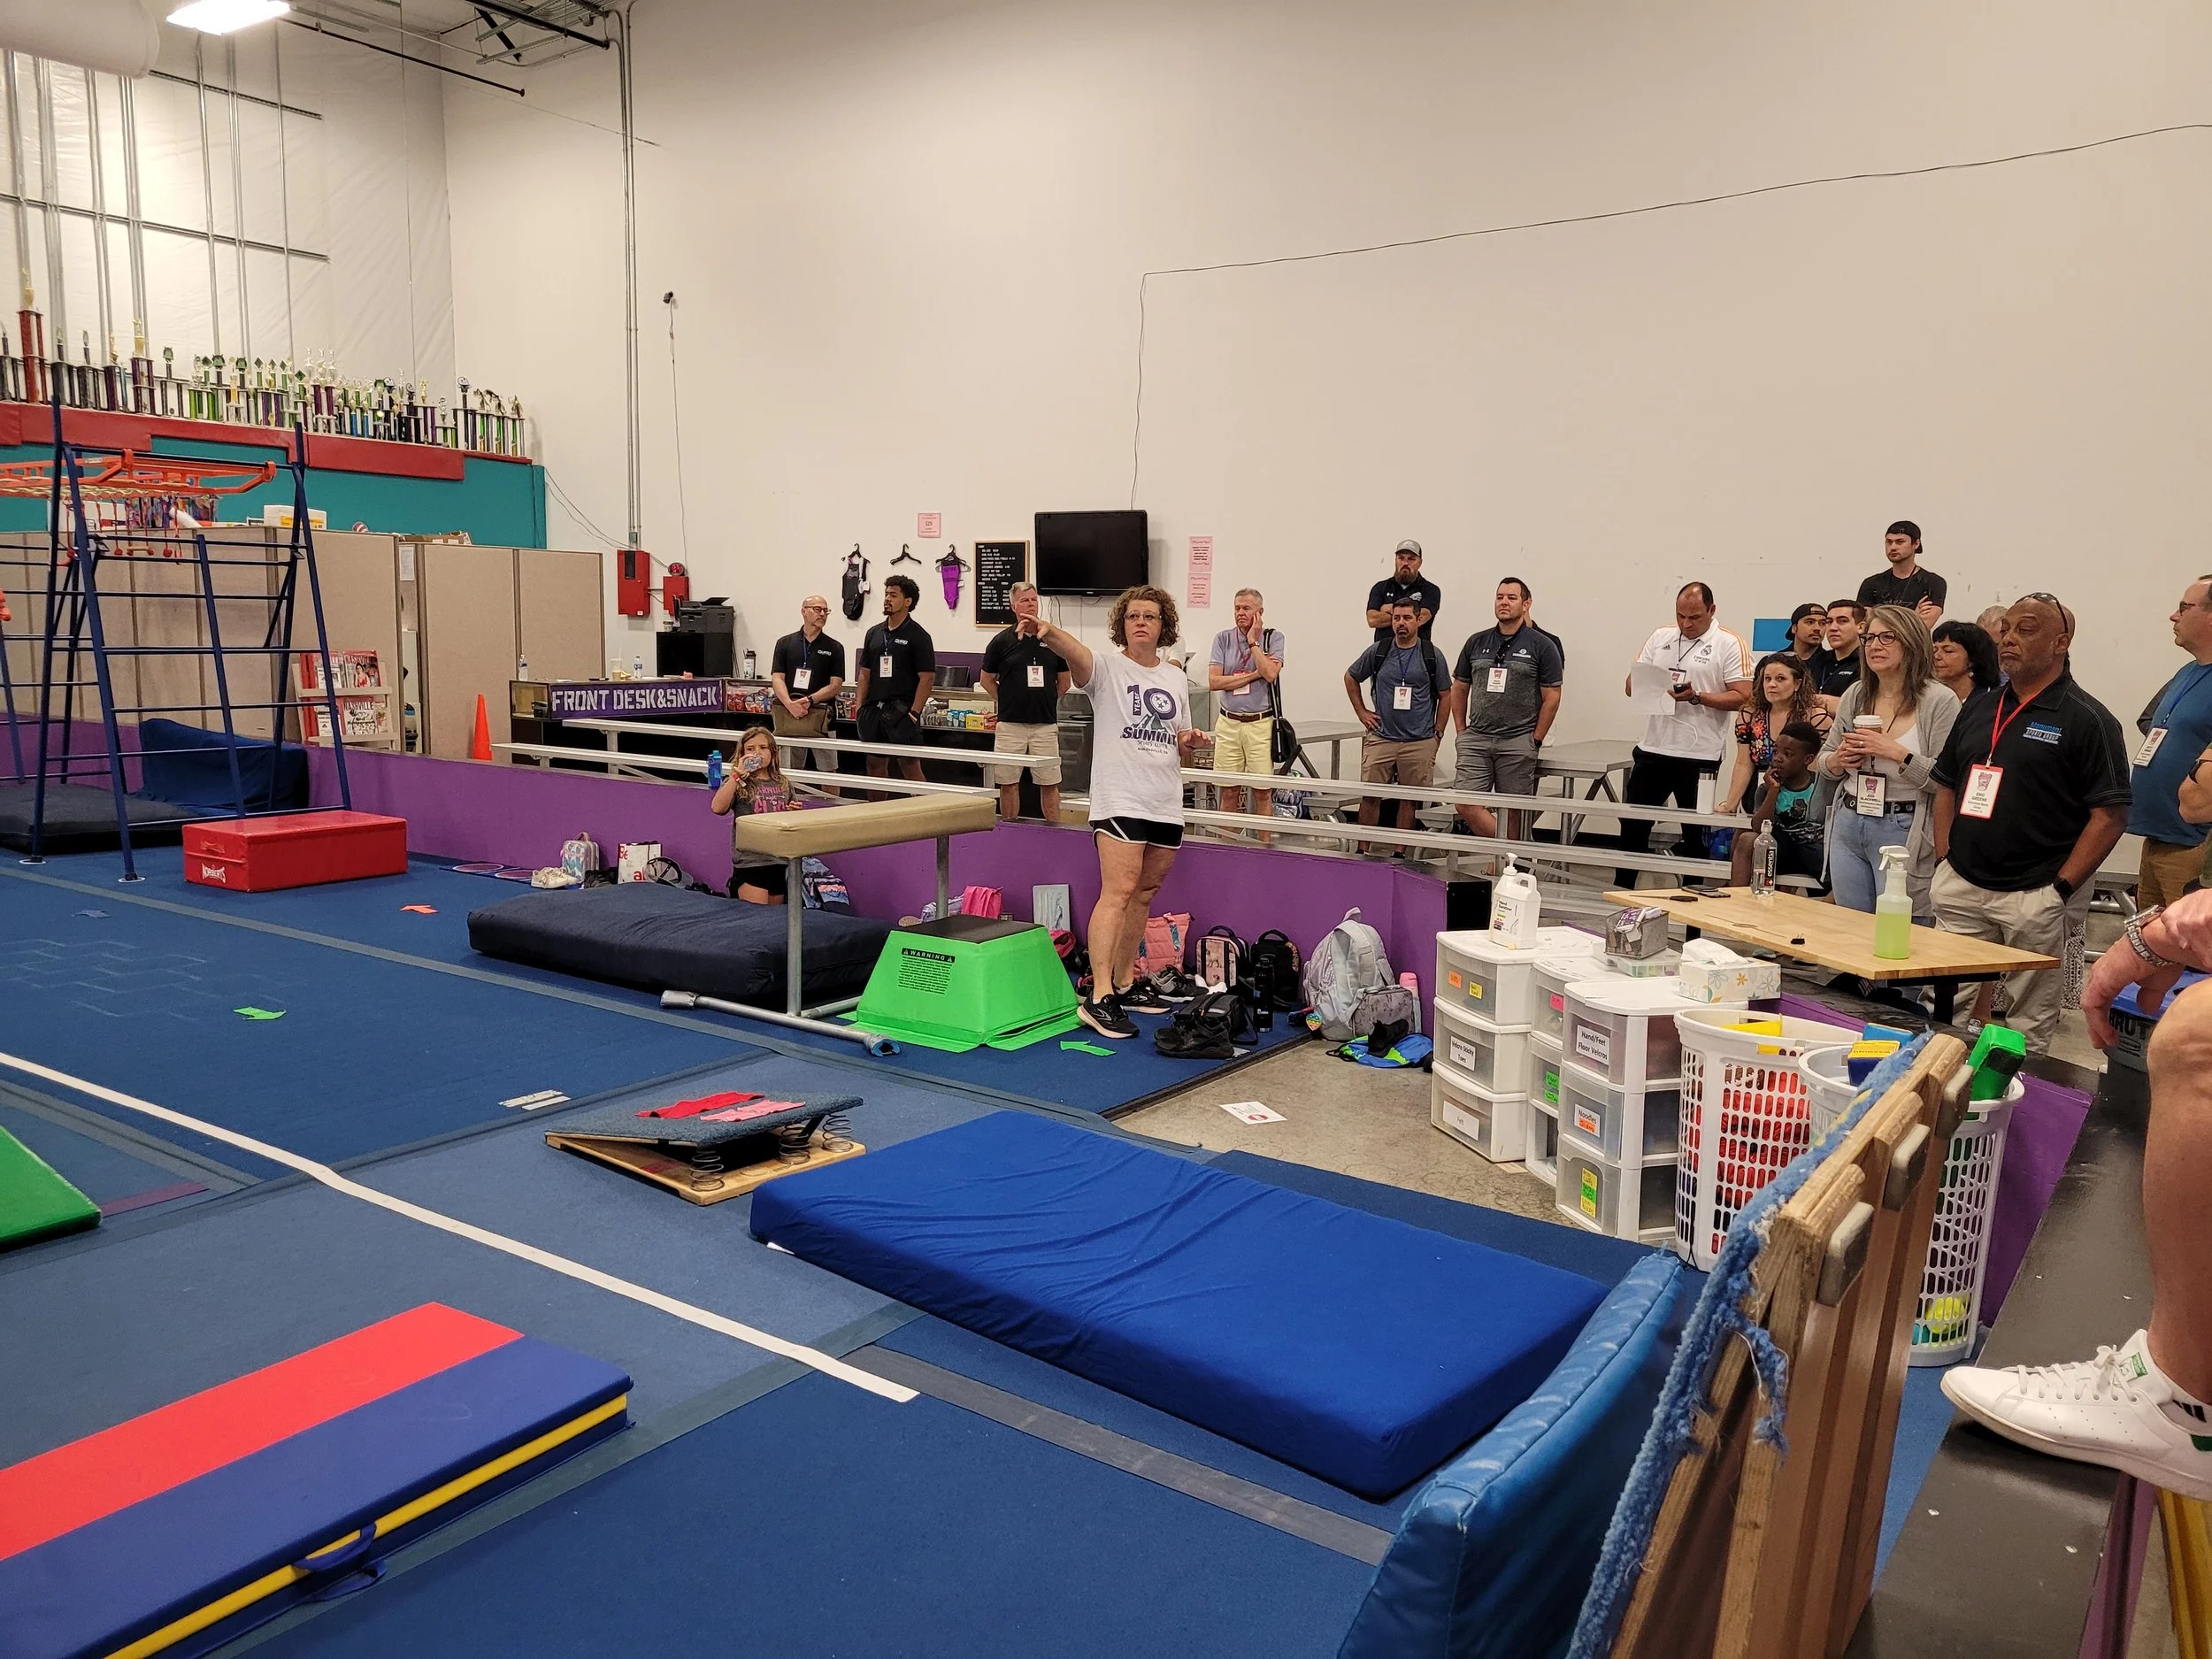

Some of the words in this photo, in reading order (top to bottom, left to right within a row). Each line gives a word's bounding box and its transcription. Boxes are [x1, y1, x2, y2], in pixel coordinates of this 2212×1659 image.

[552, 690, 610, 711] FRONT
[613, 687, 718, 710] DESK&SNACK
[2030, 722, 2062, 733] Monument
[1122, 726, 1177, 745] SUMMIT
[910, 950, 945, 961] WARNING
[1452, 1041, 1463, 1051] Velcro
[1581, 1031, 1606, 1046] Hand/Feet
[1457, 1053, 1467, 1063] Toes
[1578, 1041, 1591, 1053] Floor
[1591, 1047, 1608, 1060] Velcros
[1578, 1109, 1597, 1125] Noodles
